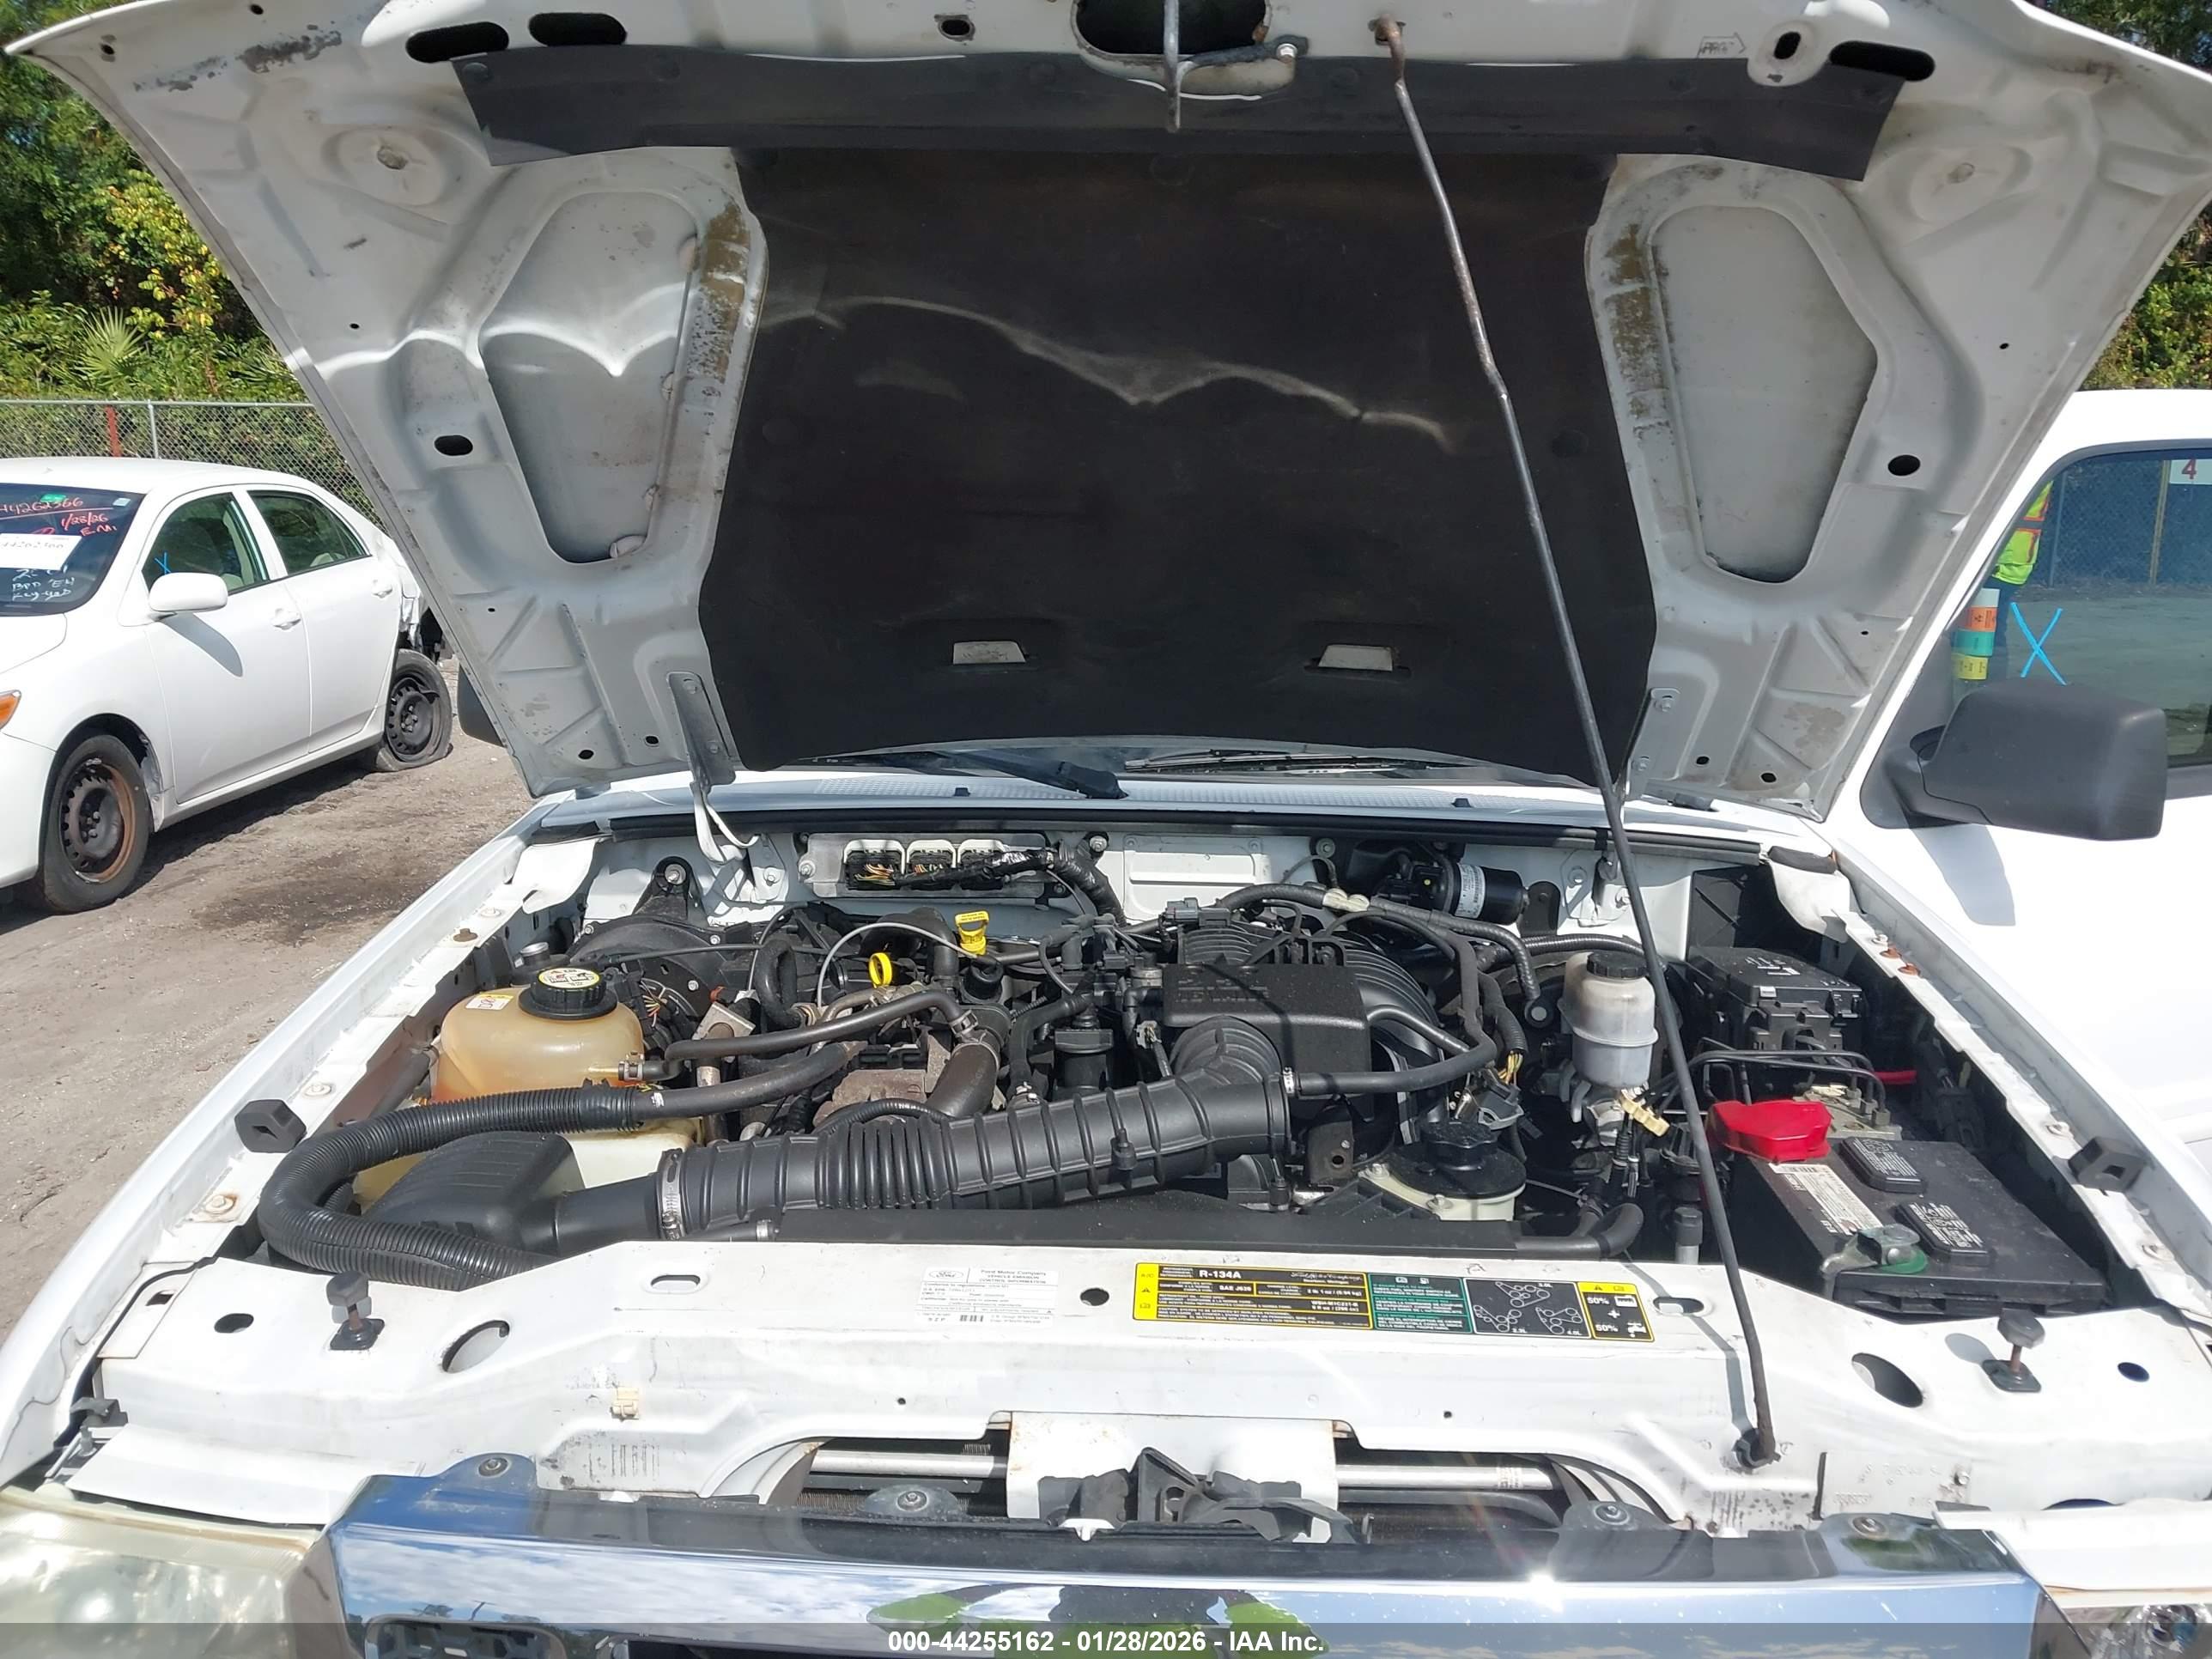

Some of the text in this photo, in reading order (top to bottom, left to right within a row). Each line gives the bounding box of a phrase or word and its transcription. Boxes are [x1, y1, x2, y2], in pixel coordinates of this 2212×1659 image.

[2181, 459, 2197, 480] 4
[1199, 1270, 1242, 1279] R-134A
[1588, 1297, 1609, 1305] 50%
[1595, 1323, 1619, 1332] 50%
